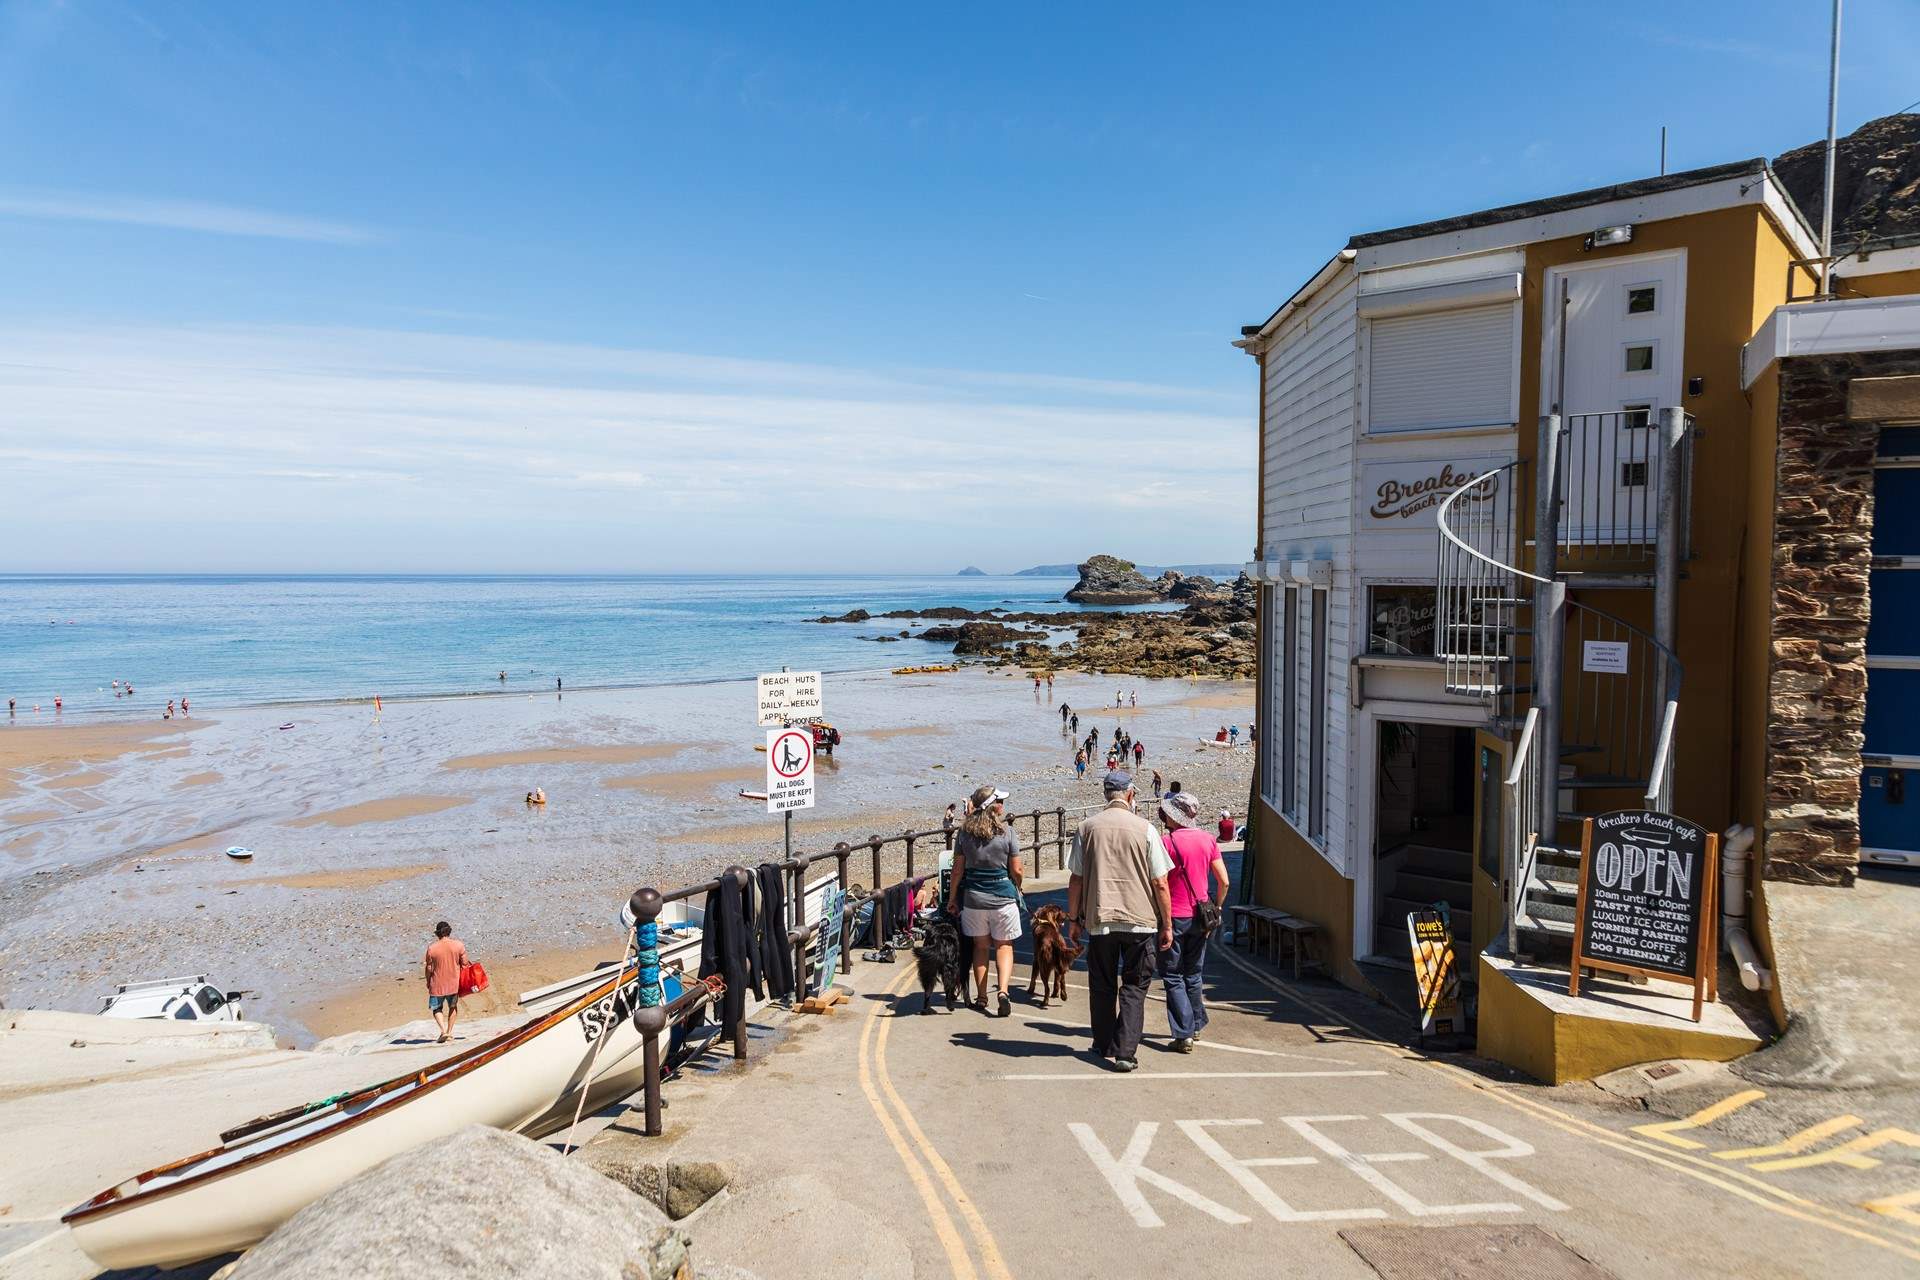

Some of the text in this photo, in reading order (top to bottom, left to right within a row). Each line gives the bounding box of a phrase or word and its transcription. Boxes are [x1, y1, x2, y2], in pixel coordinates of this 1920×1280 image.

[1400, 492, 1437, 518] beach
[763, 677, 789, 685] BEACH
[796, 688, 815, 696] HIRE
[761, 701, 783, 709] DAILY
[790, 699, 820, 707] WEEKLY
[783, 716, 823, 725] SCHOONERS
[769, 792, 786, 800] MUST
[797, 788, 812, 796] KEPT
[789, 779, 805, 787] DOGS
[786, 799, 806, 807] LEADS
[1598, 813, 1697, 841] breakers beach cafe
[1596, 842, 1694, 900] OPEN
[1595, 889, 1619, 901] 10am
[1623, 894, 1647, 904] until
[1592, 910, 1689, 934] LUXURY ICE CREAM
[1594, 900, 1691, 922] TASTY TOASTIES
[1591, 931, 1677, 954] AMAZING COFFEE
[1592, 921, 1688, 943] CORNISH PASTIES
[1590, 941, 1613, 952] DOG
[1616, 946, 1671, 963] FRIENDLY
[1067, 1112, 1574, 1228] KEEP
